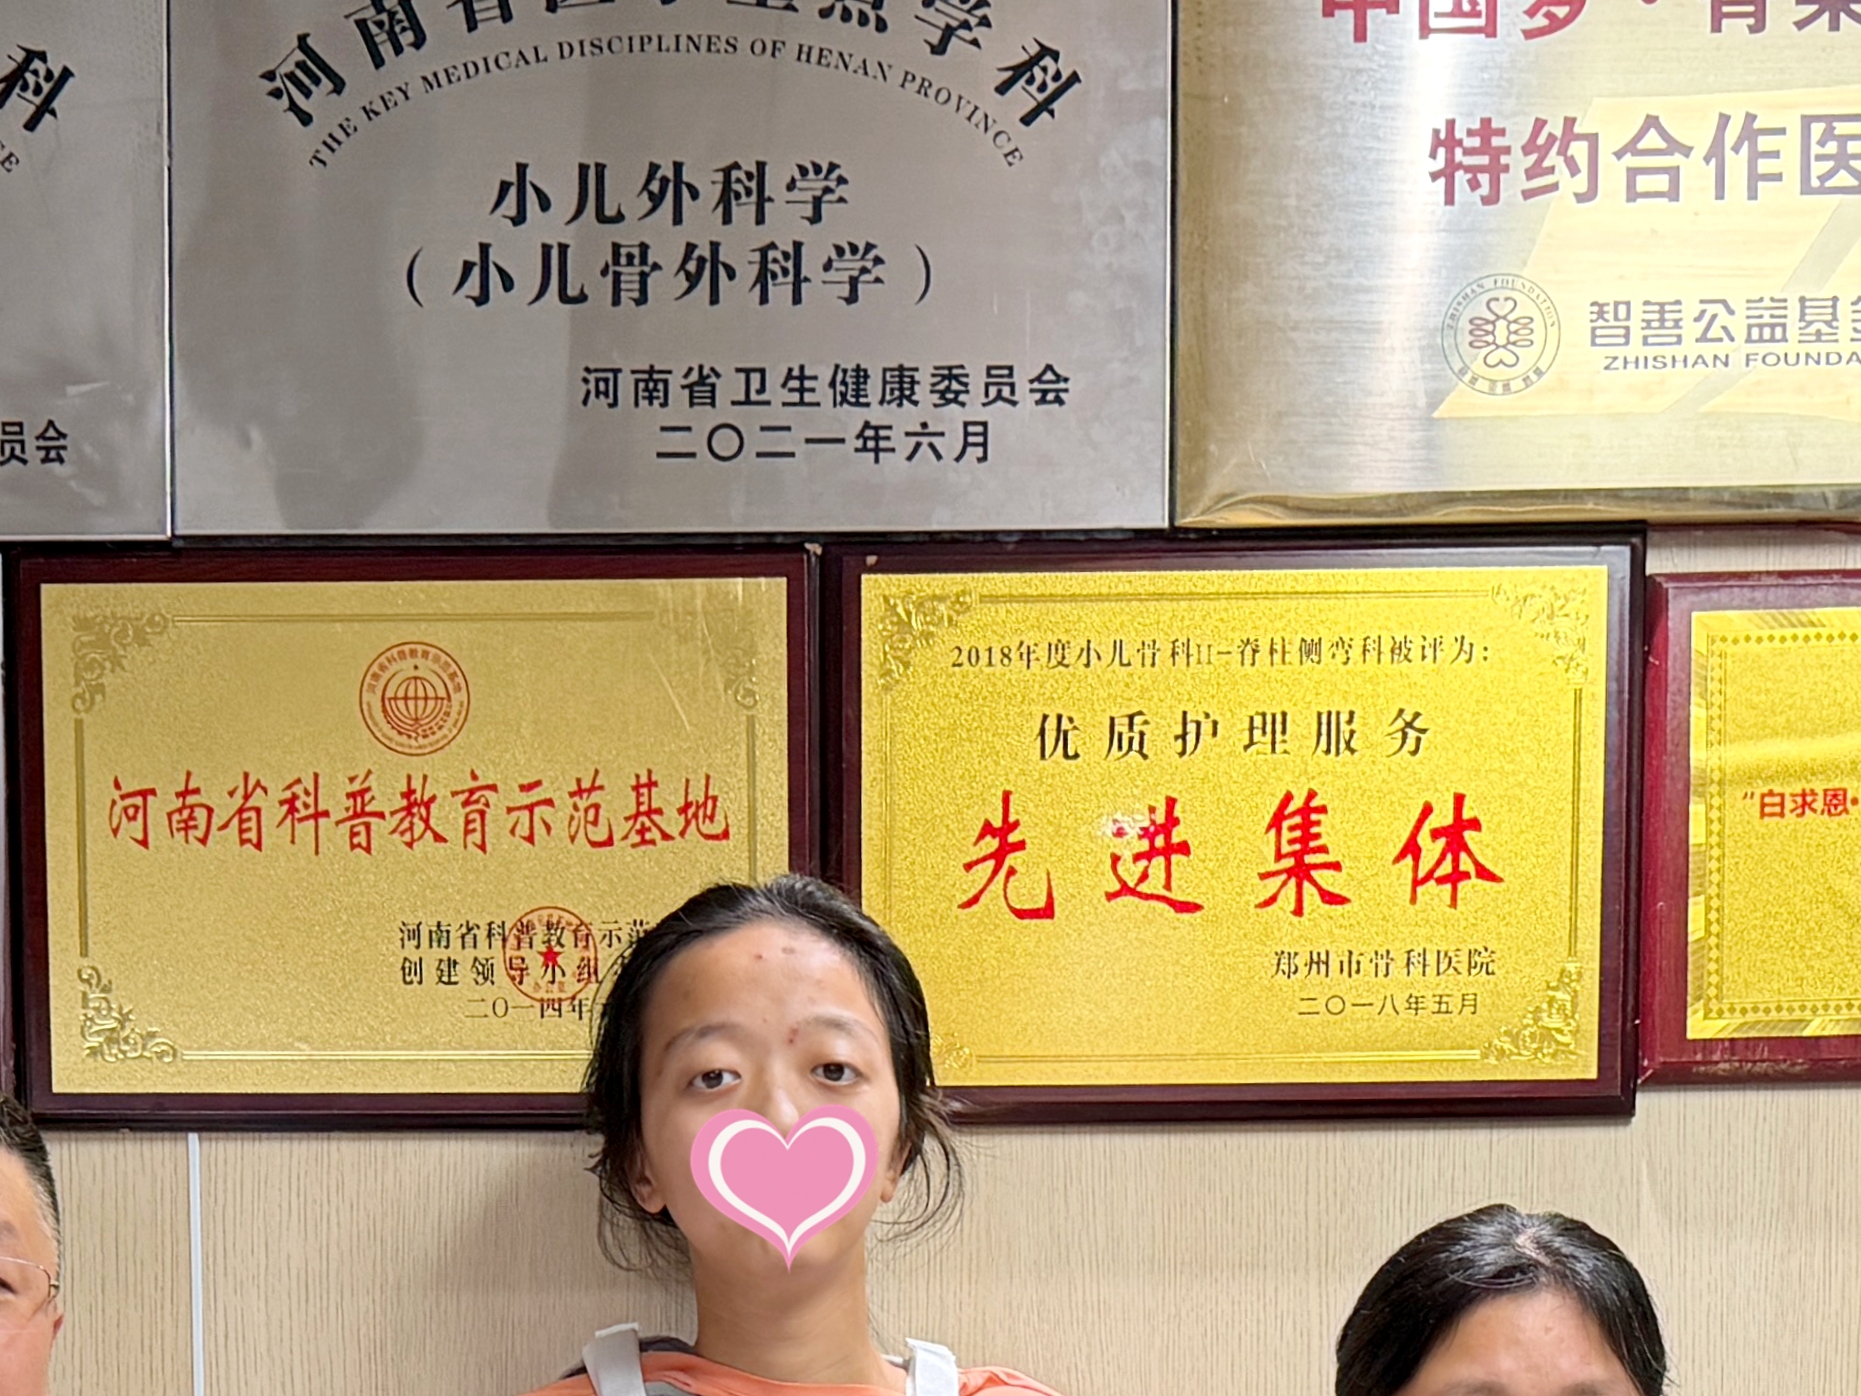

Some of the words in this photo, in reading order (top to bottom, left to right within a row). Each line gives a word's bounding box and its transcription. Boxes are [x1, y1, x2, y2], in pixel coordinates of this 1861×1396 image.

[309, 117, 359, 171] THE
[361, 82, 411, 122] KEY
[420, 45, 549, 94] MEDICAL
[558, 34, 739, 60] DISCIPLINES
[750, 38, 786, 59] OF
[796, 43, 894, 83] HENAN
[900, 70, 1024, 168] PROVINCE
[489, 160, 850, 227] 小儿外科学
[581, 363, 1072, 410] 河南省卫生健康委员会
[1602, 352, 1731, 372] ZHISHAN
[1036, 706, 1431, 762] 优质护理服务
[107, 768, 731, 856] 河南省科普教育示范基地
[957, 788, 1505, 920] 先进集体
[400, 955, 625, 987] 创建领导小组
[1272, 946, 1497, 980] 郑州市骨科医院
